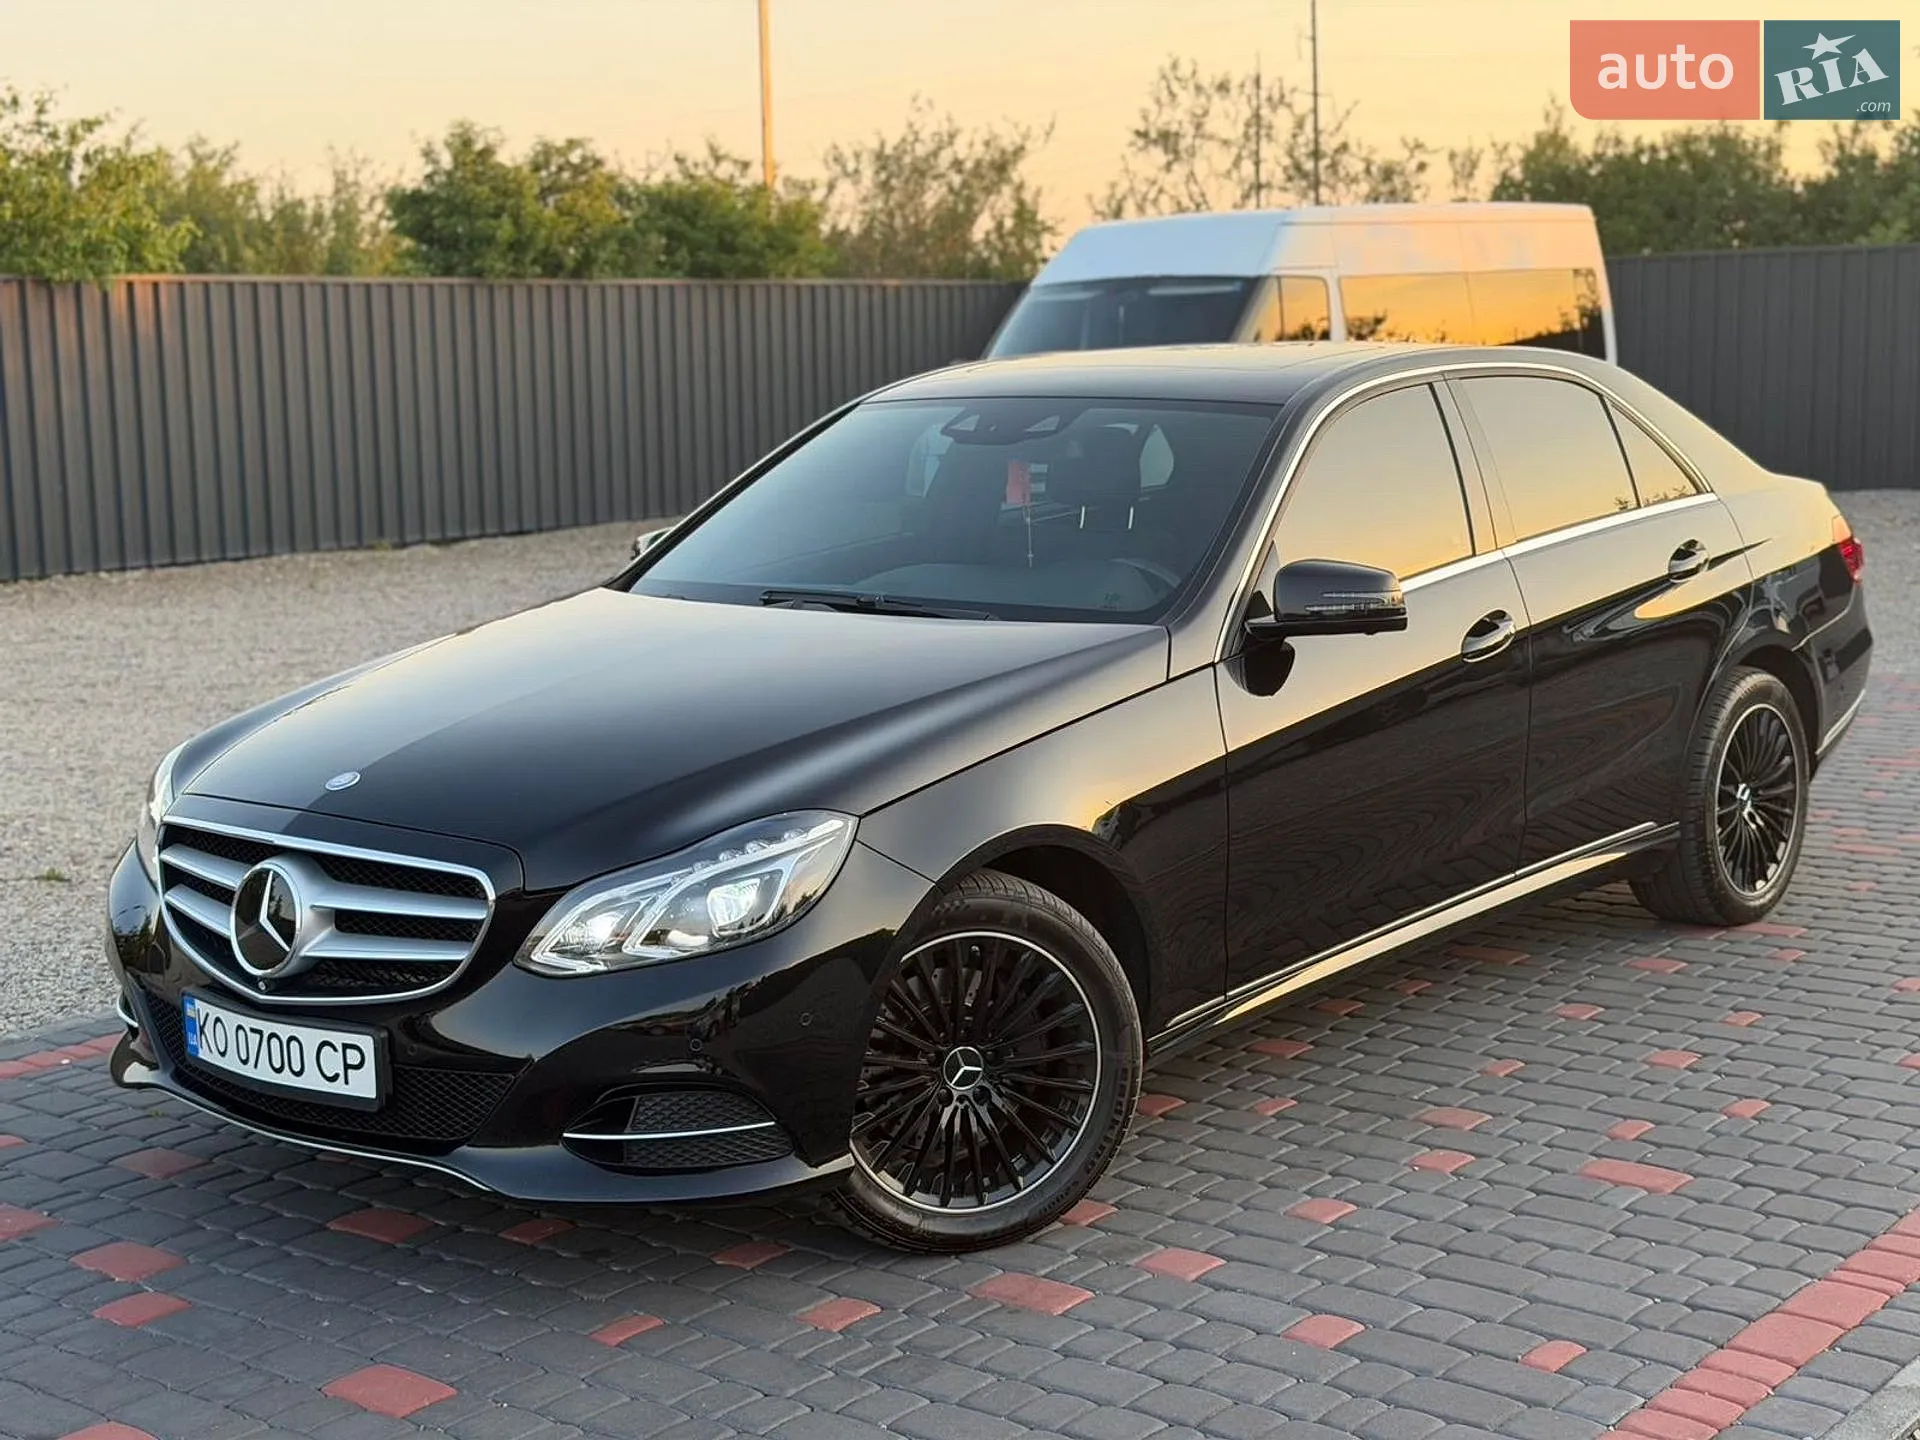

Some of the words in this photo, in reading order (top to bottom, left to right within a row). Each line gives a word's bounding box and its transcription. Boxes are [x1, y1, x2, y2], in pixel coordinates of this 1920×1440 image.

[197, 1007, 229, 1059] KO
[235, 1023, 306, 1078] 0700
[315, 1039, 366, 1086] CP
